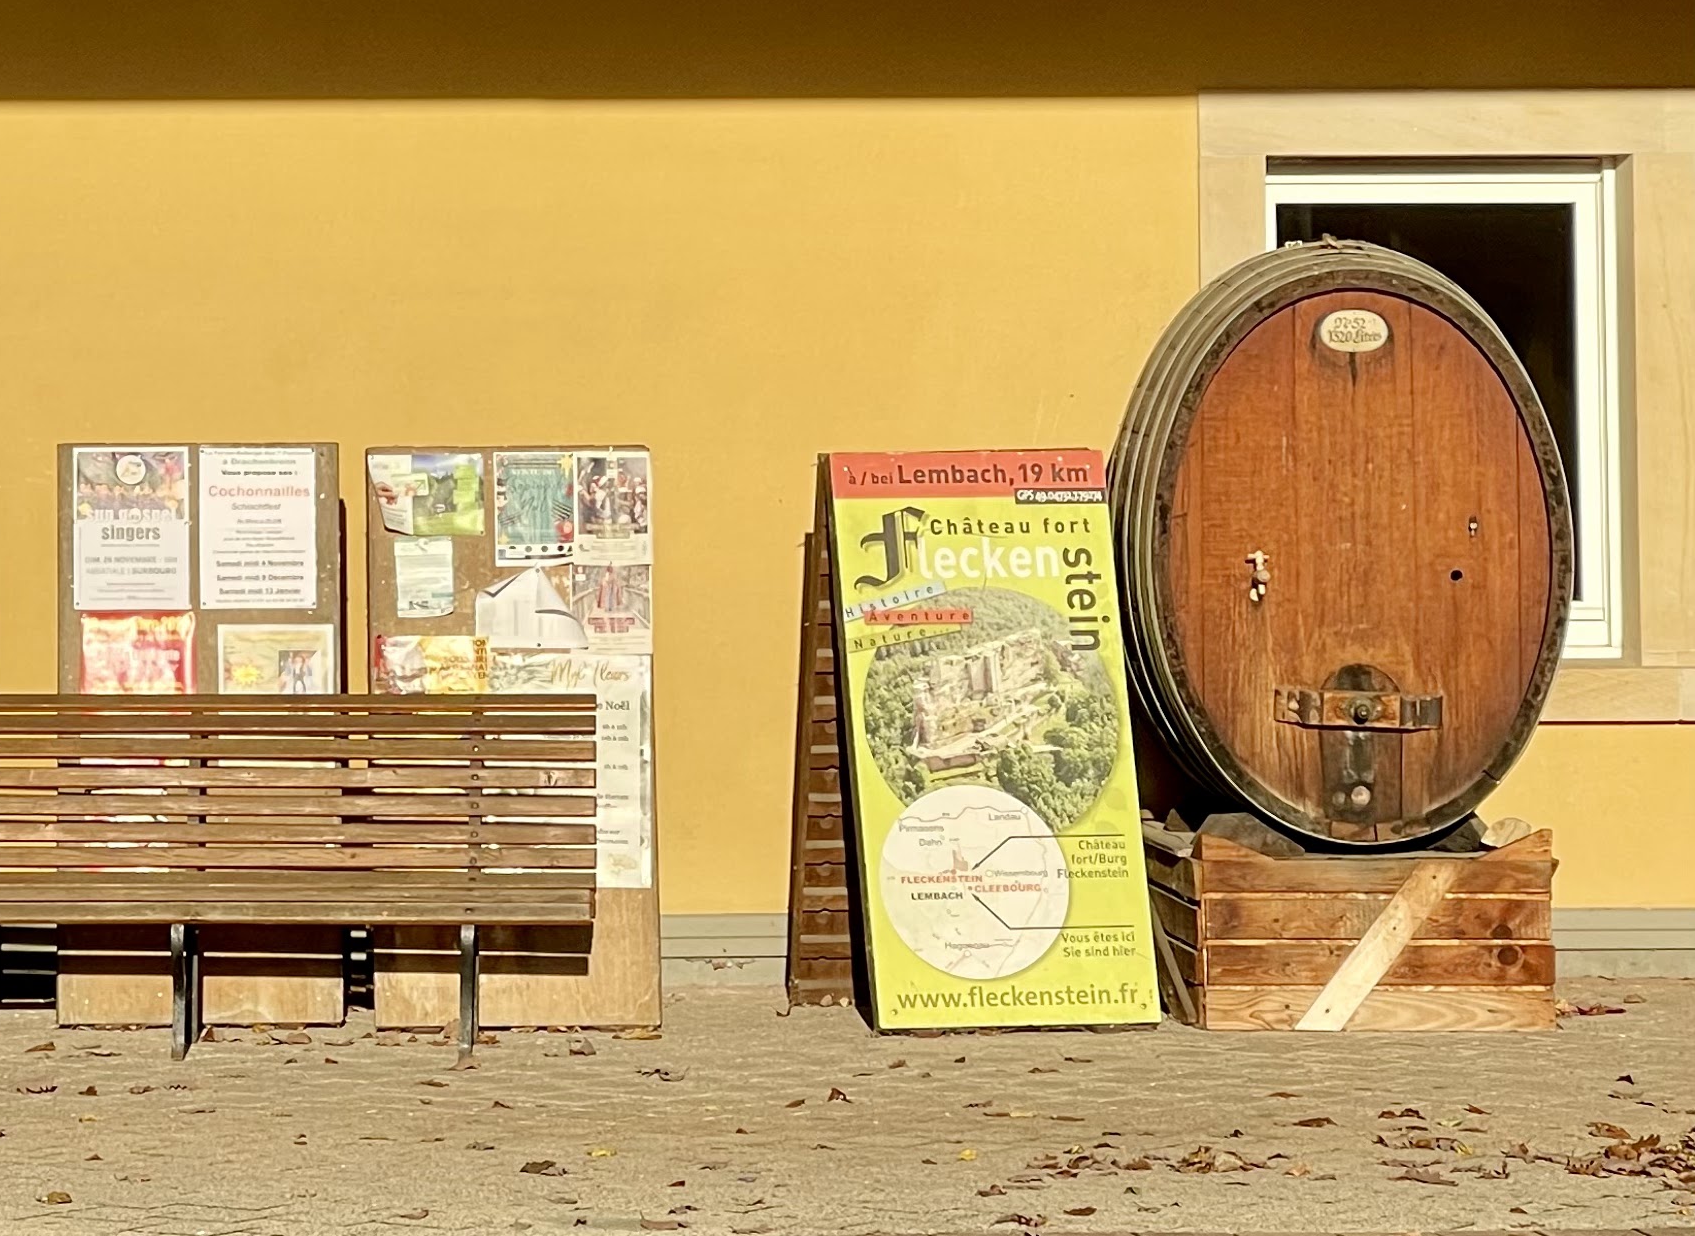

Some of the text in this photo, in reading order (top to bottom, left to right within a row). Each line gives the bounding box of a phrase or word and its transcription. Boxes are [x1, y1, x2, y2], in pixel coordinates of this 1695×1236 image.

[871, 472, 893, 484] bei
[898, 463, 1014, 486] Lembach,
[1018, 463, 1043, 483] 19
[1051, 462, 1088, 482] km
[208, 485, 310, 497] Cochonnailles
[930, 517, 1090, 535] Château fort
[101, 524, 161, 542] singers
[846, 586, 934, 618] Histoire
[869, 611, 969, 621] Aventure
[919, 838, 943, 847] Dahn
[1078, 839, 1126, 850] Château
[1072, 853, 1127, 866] fort/Burg
[1057, 866, 1129, 879] Fleckenstein
[901, 875, 983, 884] FLECKENSTEIN
[974, 883, 1041, 893] CLEEBOURG
[911, 892, 963, 900] LEMBACH
[1061, 931, 1135, 943] Vous êtes ici
[1063, 945, 1136, 958] Sie sind hier
[897, 982, 1138, 1009] www.fleckenstein.fr
